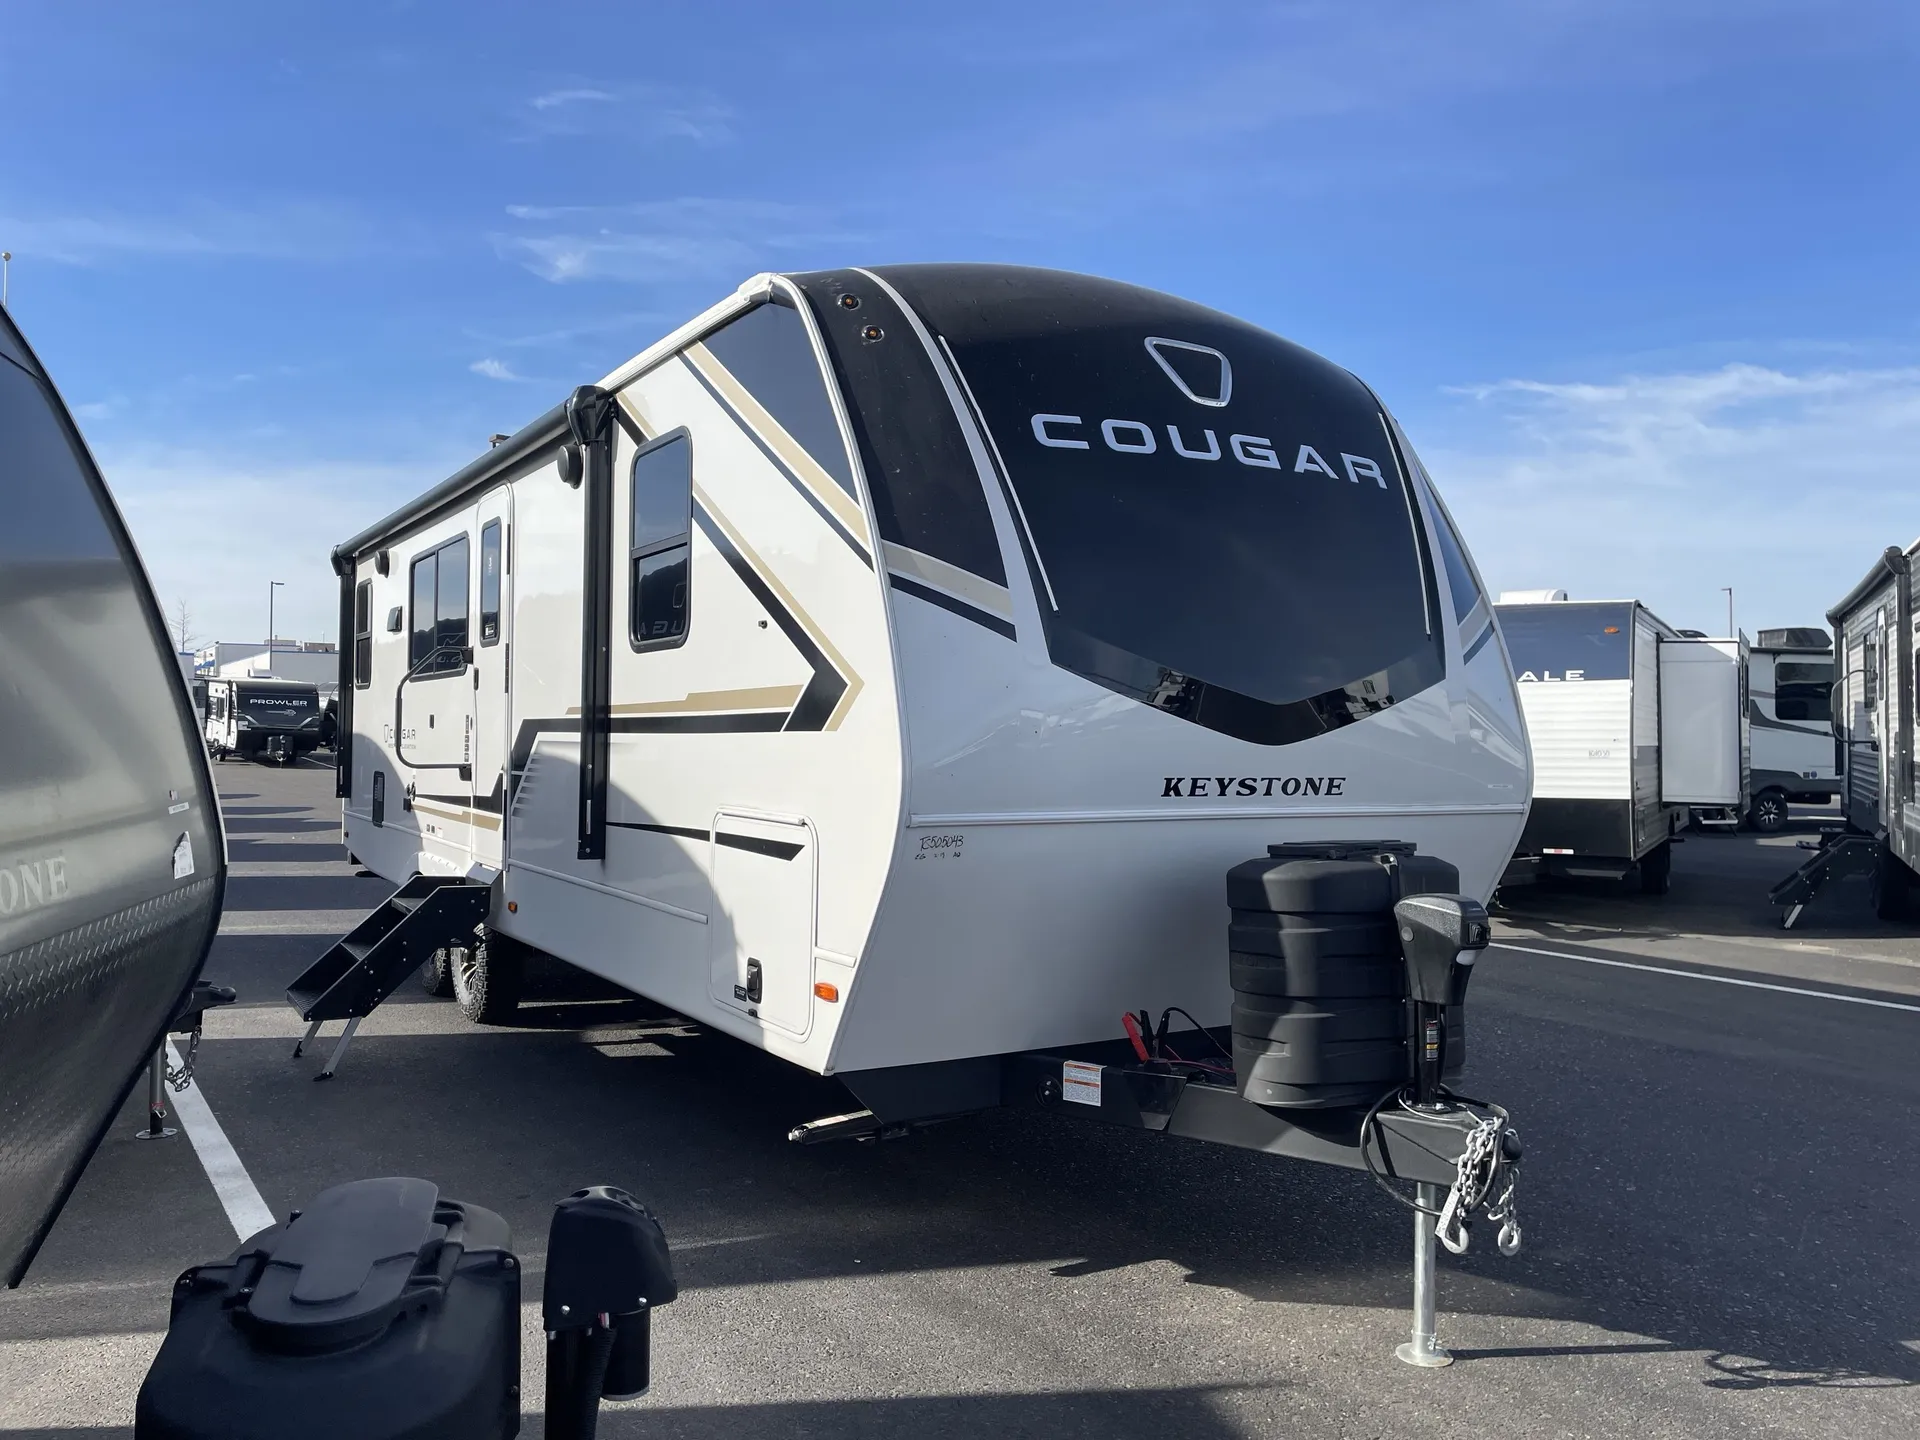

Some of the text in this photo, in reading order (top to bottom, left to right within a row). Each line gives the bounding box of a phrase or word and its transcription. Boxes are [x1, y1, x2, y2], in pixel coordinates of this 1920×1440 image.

[1030, 412, 1388, 490] COUGAR
[1517, 669, 1585, 682] ALE
[249, 698, 308, 706] PROWLER
[389, 728, 416, 740] CGAR
[1160, 777, 1346, 798] KEYSTONE
[0, 856, 69, 914] ONE
